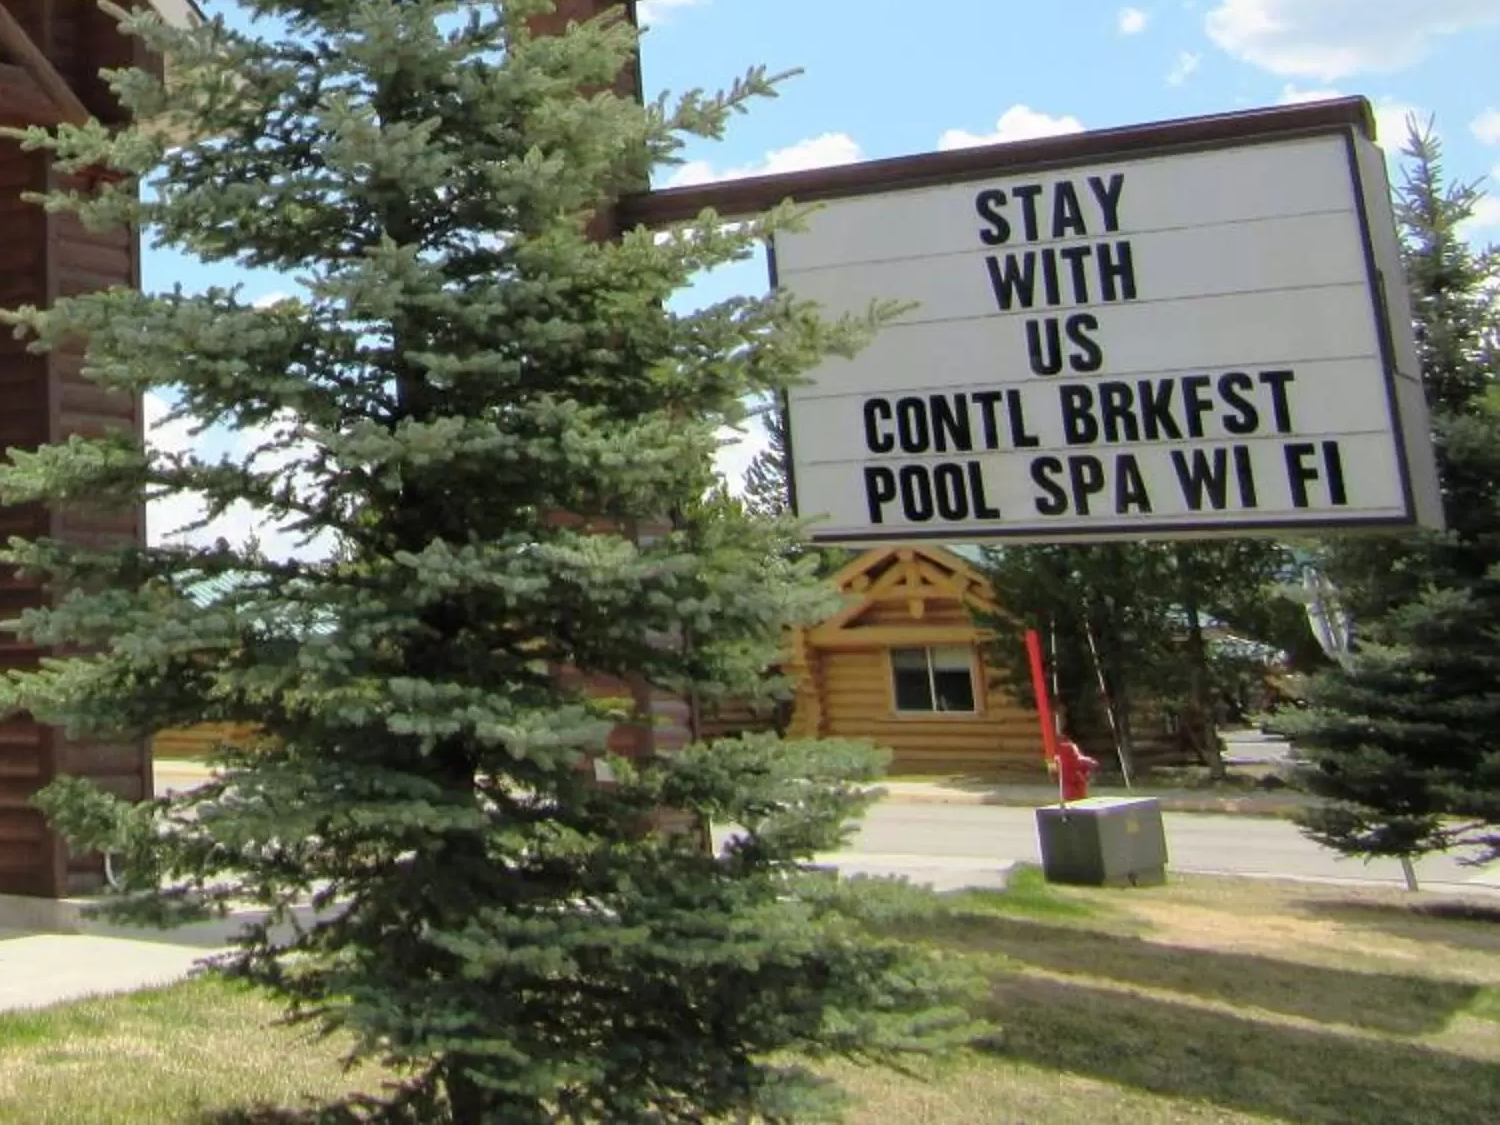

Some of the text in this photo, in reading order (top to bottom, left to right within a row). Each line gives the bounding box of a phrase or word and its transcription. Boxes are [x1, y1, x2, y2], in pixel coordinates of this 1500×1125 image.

[975, 174, 1125, 246] STAY
[985, 241, 1138, 311] WITH
[1025, 313, 1104, 376] US
[863, 370, 1295, 454] CONTL BRKFST
[863, 440, 1349, 524] POOL SPA WI FI
